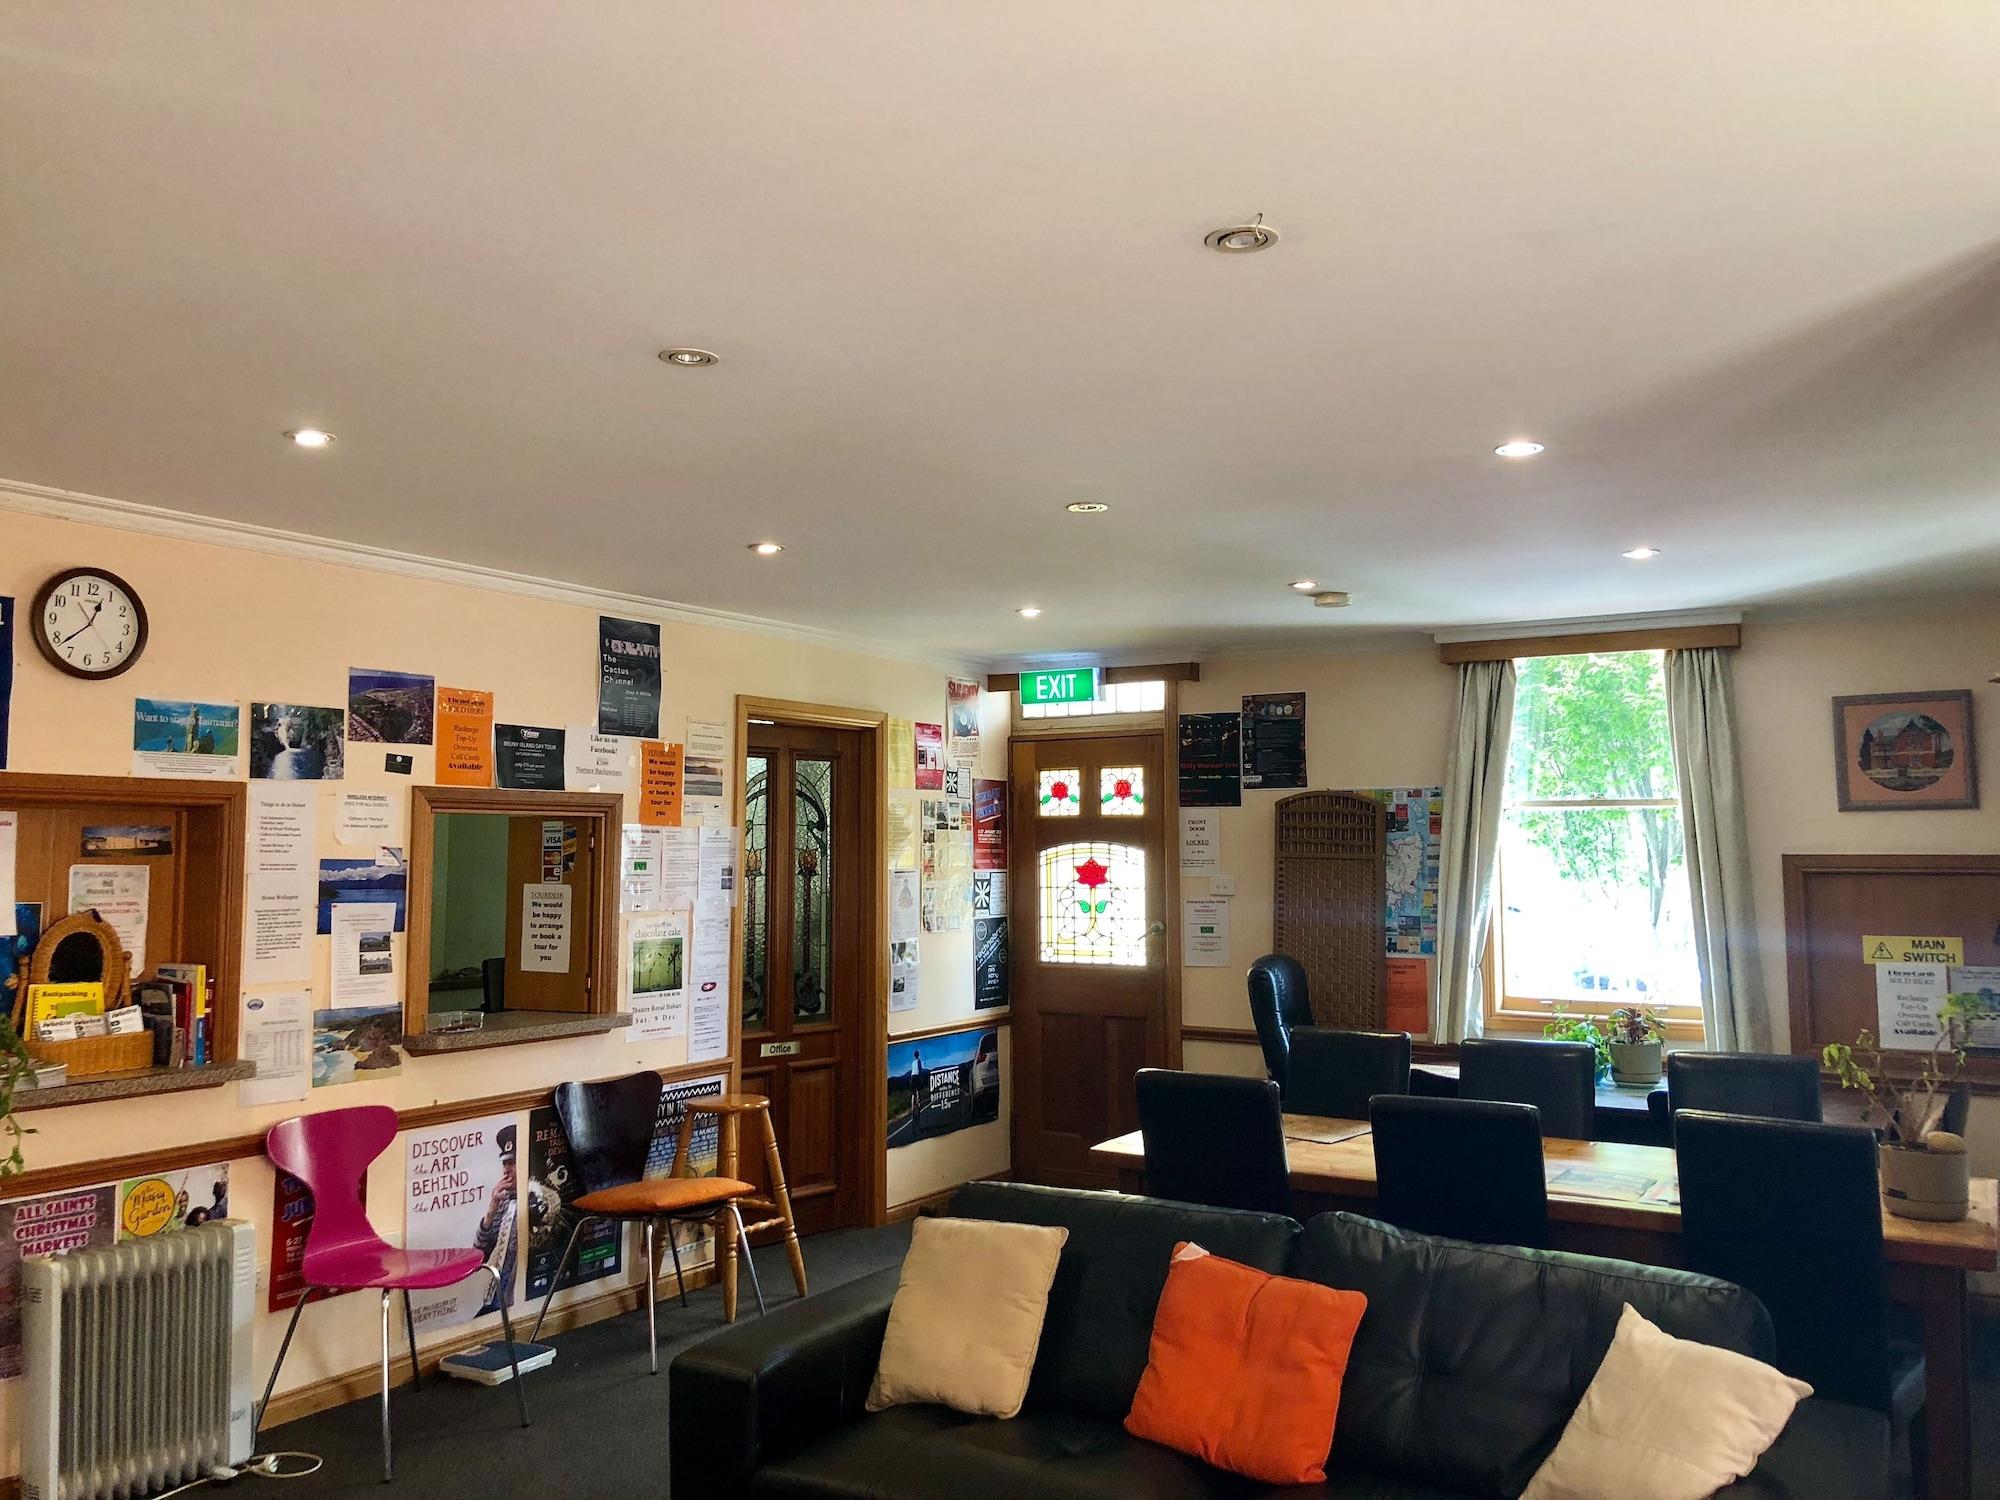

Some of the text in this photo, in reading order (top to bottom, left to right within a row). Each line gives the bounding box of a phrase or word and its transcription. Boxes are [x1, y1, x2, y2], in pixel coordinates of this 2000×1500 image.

[71, 584, 80, 596] 11
[87, 583, 99, 595] 12
[54, 595, 66, 608] 10
[109, 591, 113, 602] 1
[119, 606, 126, 617] 2
[49, 613, 57, 624] 9
[122, 624, 130, 636] 3
[53, 631, 61, 643] 8
[67, 647, 75, 658] 7
[115, 641, 122, 653] 4
[84, 654, 91, 666] 6
[103, 652, 110, 663] 5
[603, 654, 616, 663] The
[604, 665, 629, 675] Cactus
[1036, 674, 1077, 700] EXIT
[136, 712, 157, 723] Want
[198, 716, 239, 728] Tasmania?
[456, 734, 477, 743] Top-Up
[590, 746, 618, 754] Facebook!
[448, 762, 483, 770] Available
[546, 836, 562, 845] VISA
[541, 912, 561, 920] happy
[634, 928, 667, 938] chocolate
[1911, 940, 1945, 949] MAIN
[1903, 952, 1956, 963] SWITCH
[770, 1045, 792, 1054] Office
[930, 1070, 960, 1092] DISTANCE
[931, 1088, 960, 1101] DIFFERENCE
[412, 1131, 483, 1159] DISCOVER
[413, 1154, 460, 1175] the ART
[412, 1171, 469, 1197] BEHIND
[413, 1185, 485, 1213] the ARTIST
[16, 1194, 97, 1222] ALL SAINTS
[130, 1202, 171, 1232] Garden
[15, 1214, 96, 1240] CHRISTMAS
[22, 1232, 88, 1257] MARKETS
[413, 1305, 457, 1323] VERYTHING
